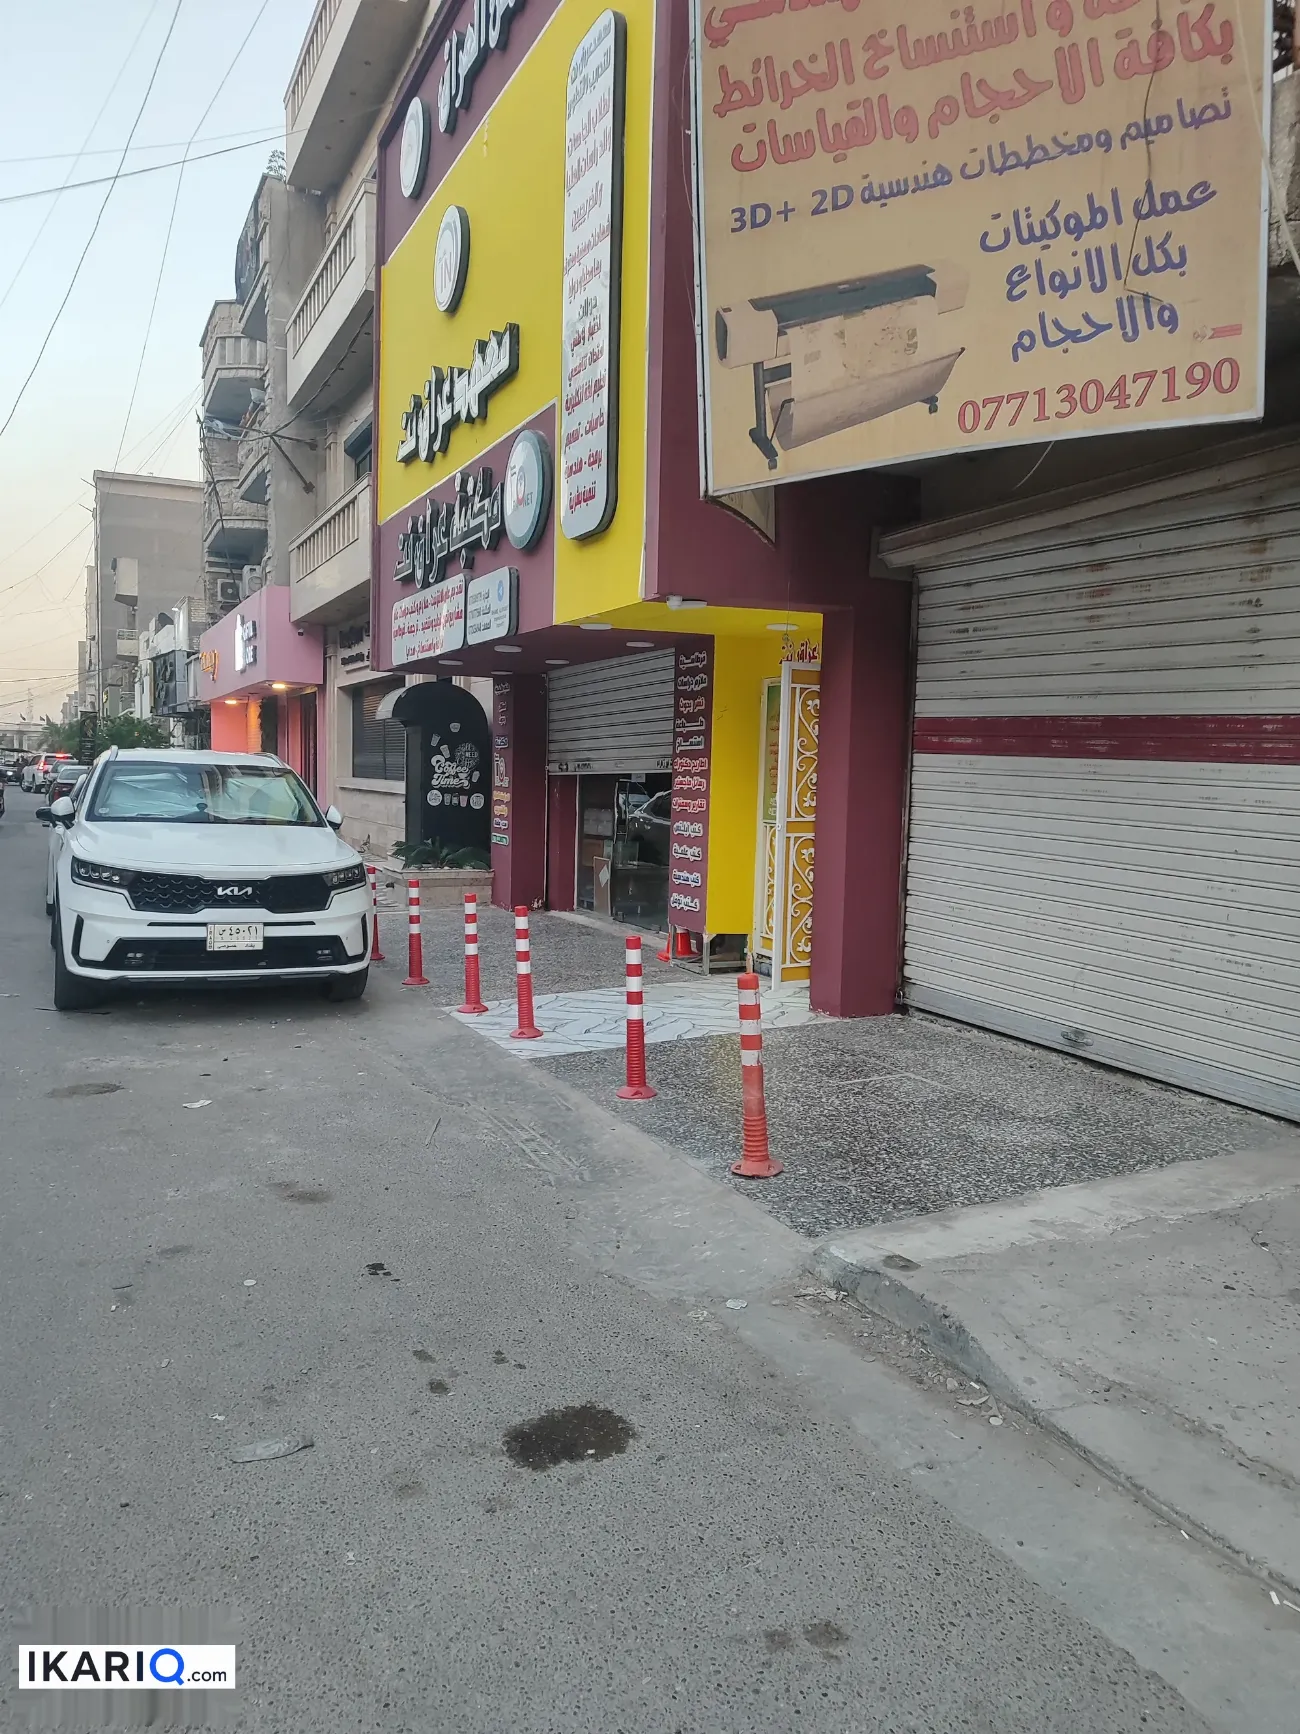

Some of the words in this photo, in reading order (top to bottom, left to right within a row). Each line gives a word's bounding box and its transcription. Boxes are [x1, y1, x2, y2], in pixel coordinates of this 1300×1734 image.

[863, 6, 1036, 80] استنساخ
[1113, 4, 1235, 75] بكافة
[711, 37, 857, 118] الخرائط
[926, 37, 1104, 140] الاحجام
[730, 93, 920, 172] والقياسات
[1118, 86, 1232, 150] تصاميم
[861, 160, 953, 205] هندسية
[958, 126, 1112, 182] ومخططات
[810, 182, 855, 217] 2D
[1132, 180, 1218, 220] عمل
[1005, 242, 1122, 303] الانواع
[1132, 230, 1188, 279] بكل
[578, 295, 598, 321] دورات
[1011, 292, 1179, 363] والاحجام
[453, 322, 513, 422] معهد
[957, 356, 1241, 436] 07713047190
[416, 366, 453, 461] عراق
[414, 498, 449, 589] عراق
[449, 467, 501, 568] مكتبة
[679, 650, 708, 671] قرطاسية
[432, 773, 471, 789] Time
[434, 760, 470, 775] Coffee
[689, 846, 702, 862] كتب
[690, 822, 703, 838] كتب
[690, 871, 702, 888] كتب
